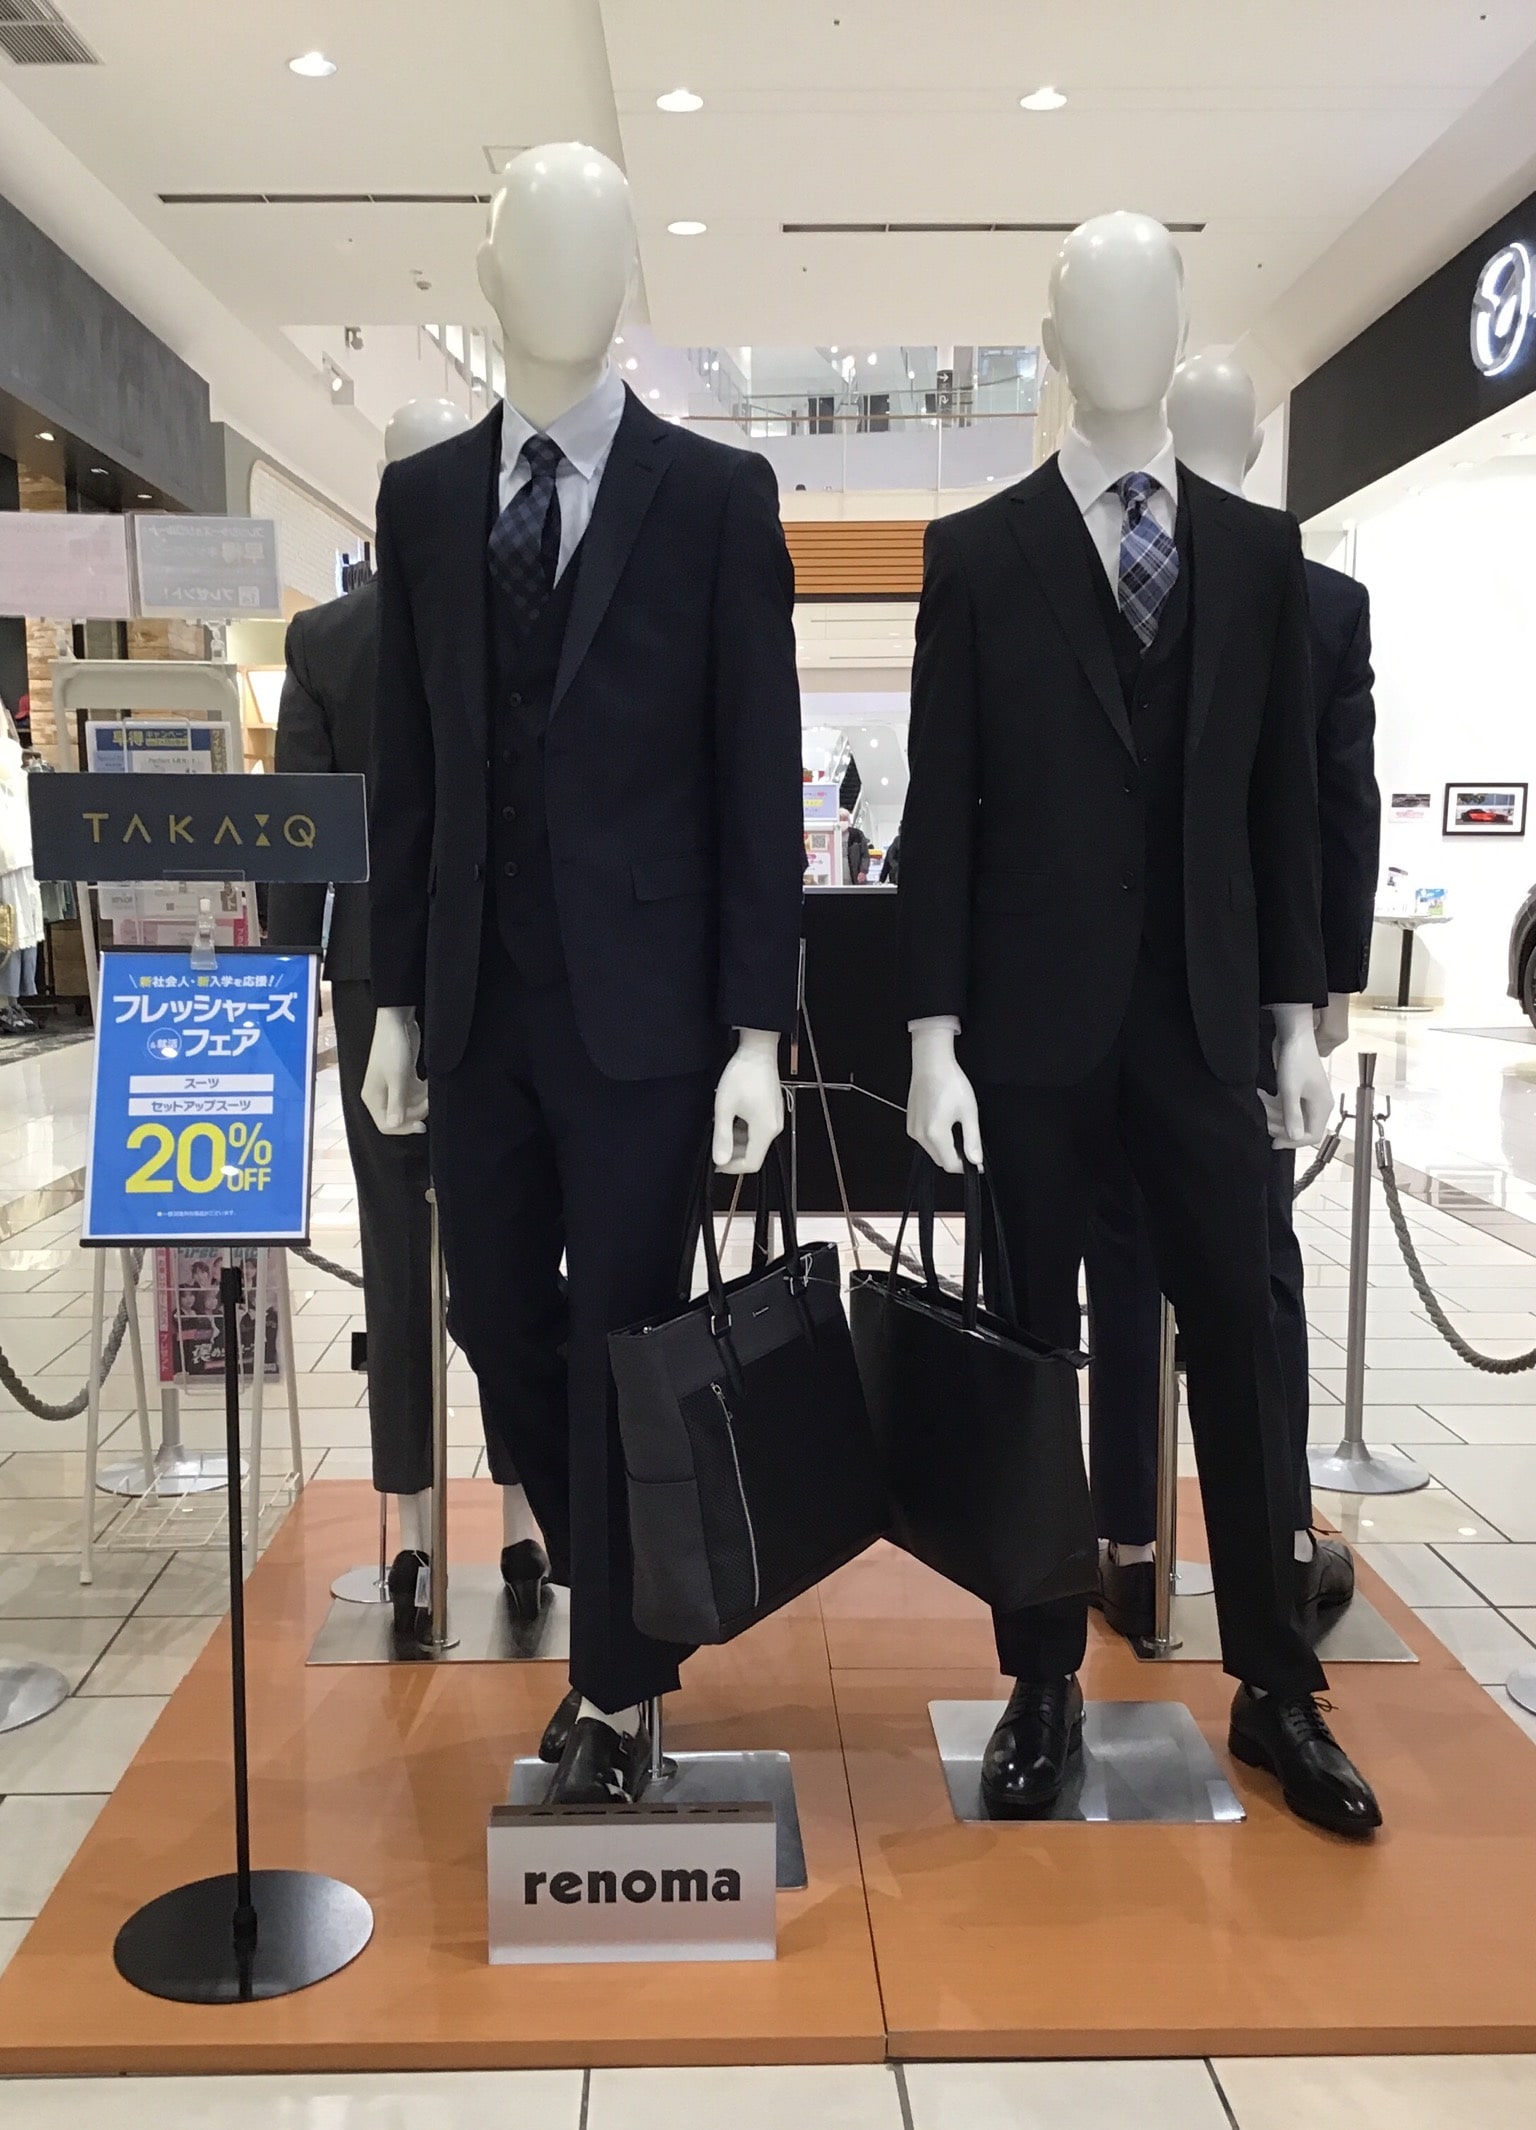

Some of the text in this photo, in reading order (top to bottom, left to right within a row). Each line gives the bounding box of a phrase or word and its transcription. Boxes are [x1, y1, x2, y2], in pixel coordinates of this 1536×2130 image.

[113, 992, 298, 1023] フレッシャーズ
[182, 1028, 261, 1057] フェア
[184, 1078, 220, 1089] スーツ
[151, 1100, 252, 1112] セットアップスーツ
[226, 1168, 272, 1192] OFF
[524, 1868, 741, 1905] renoma
